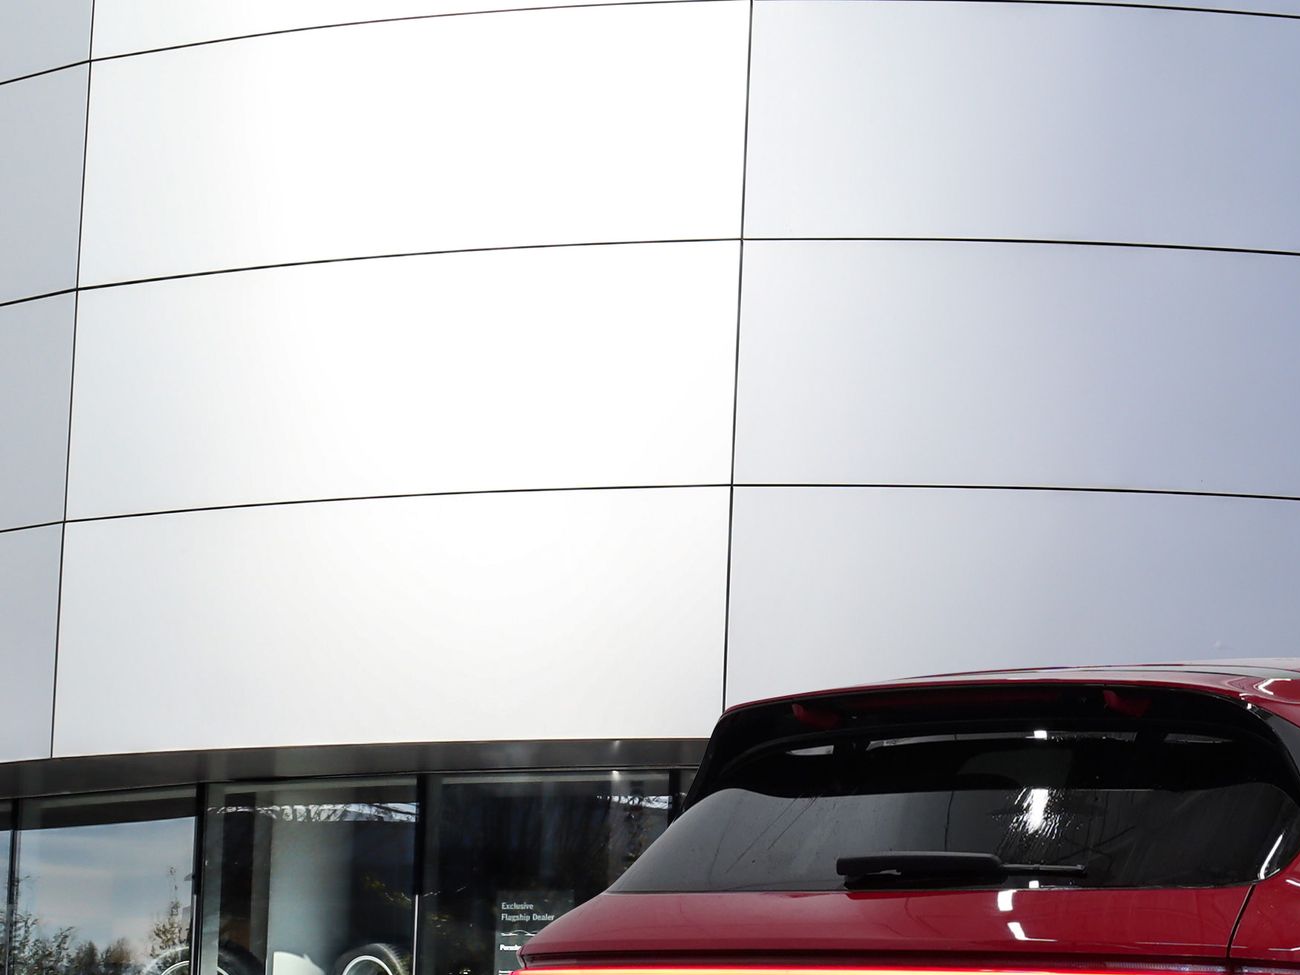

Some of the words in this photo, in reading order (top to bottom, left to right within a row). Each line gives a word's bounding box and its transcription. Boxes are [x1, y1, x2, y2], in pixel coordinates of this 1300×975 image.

[501, 902, 534, 910] Exclusive
[501, 913, 531, 922] Flagship
[532, 913, 555, 921] Dealer
